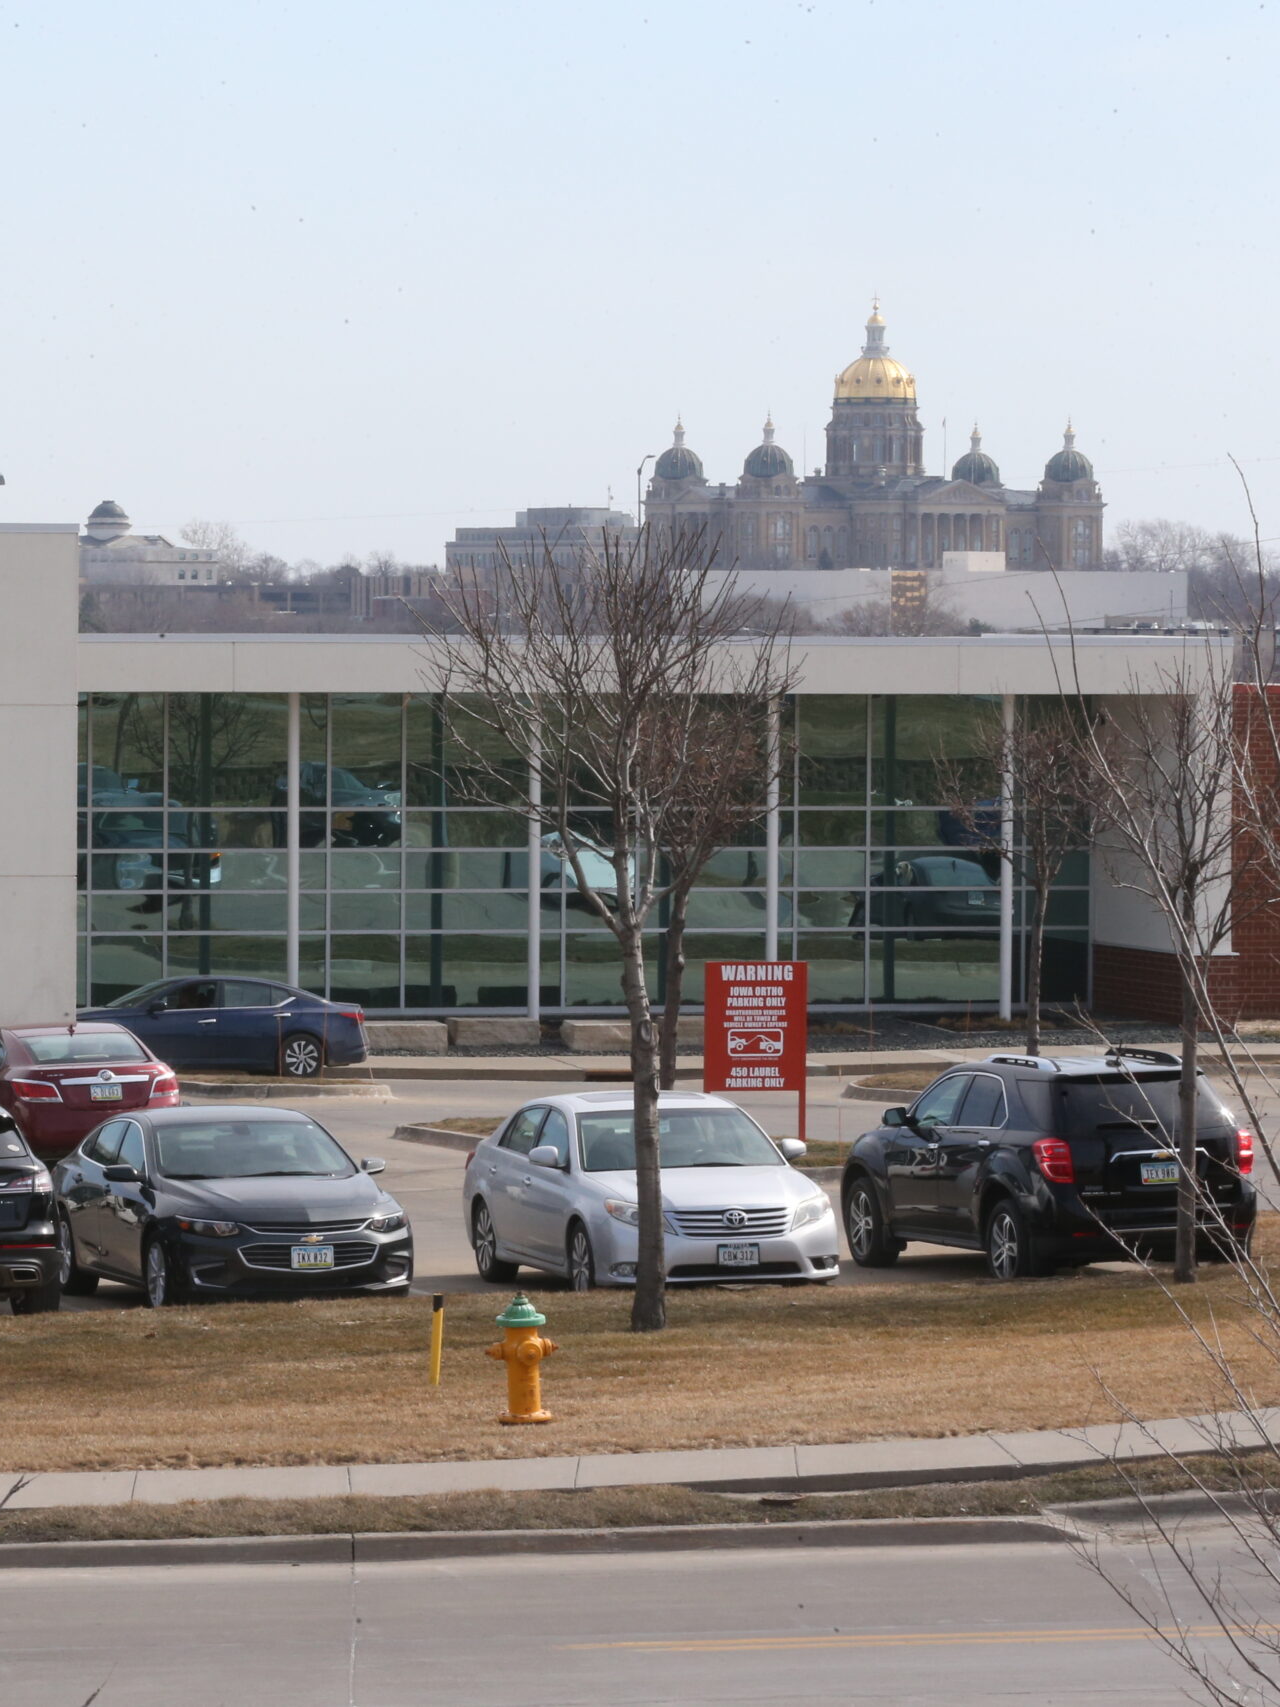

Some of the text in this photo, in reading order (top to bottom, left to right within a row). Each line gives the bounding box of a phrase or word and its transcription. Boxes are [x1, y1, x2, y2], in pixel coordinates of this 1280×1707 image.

[721, 965, 793, 981] WARNING
[730, 986, 783, 996] IOWA ORTHO
[727, 997, 786, 1007] PARKING ONLY
[731, 1067, 780, 1077] 450 LAUREL
[726, 1078, 785, 1088] PARKING ONLY
